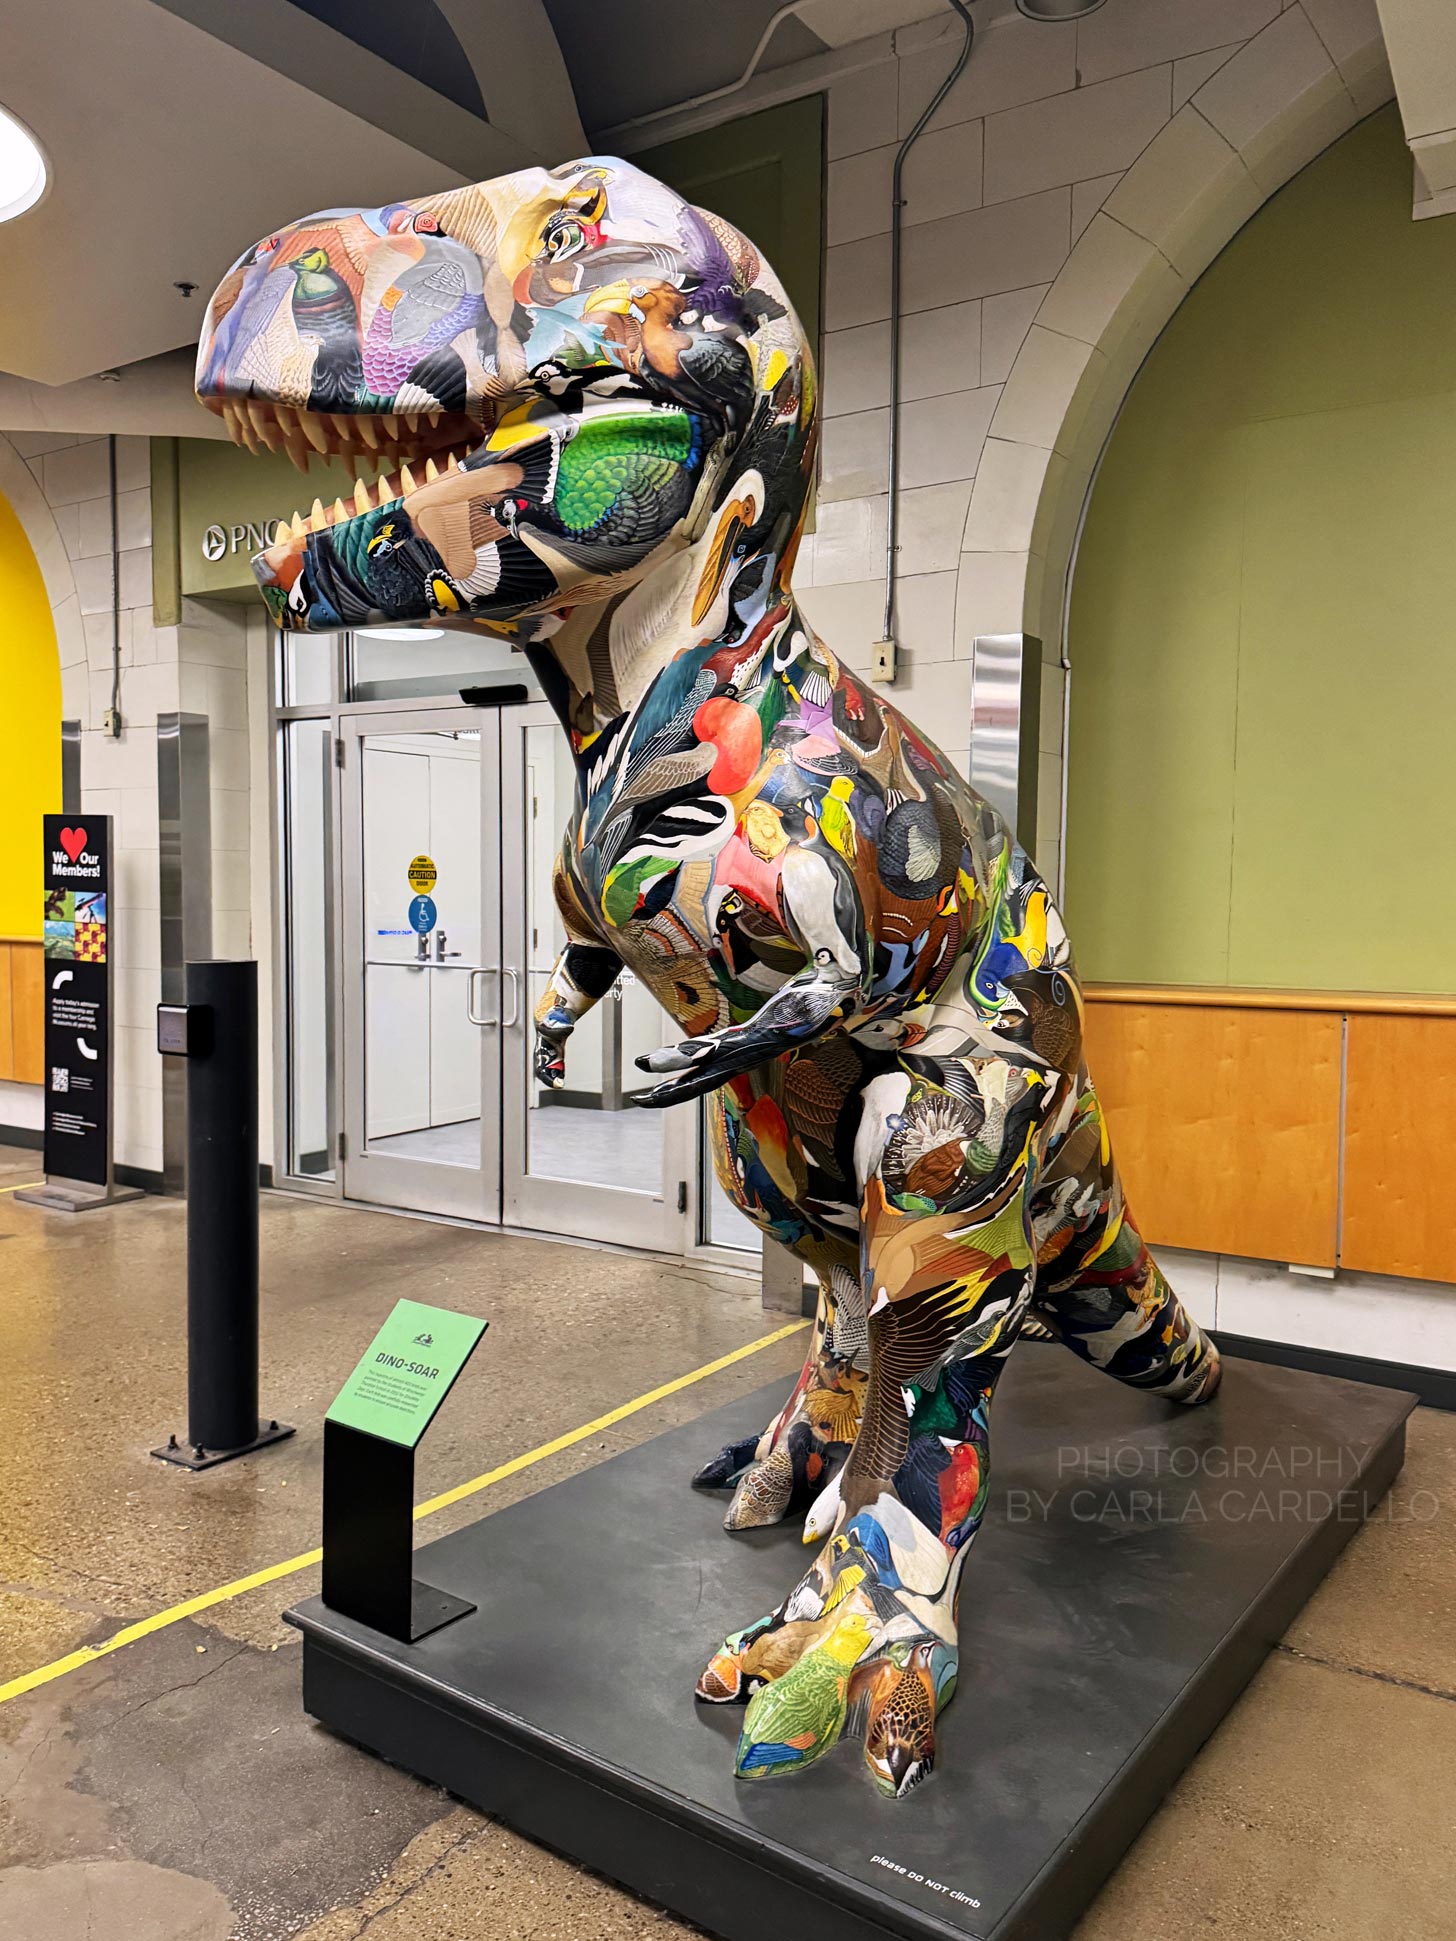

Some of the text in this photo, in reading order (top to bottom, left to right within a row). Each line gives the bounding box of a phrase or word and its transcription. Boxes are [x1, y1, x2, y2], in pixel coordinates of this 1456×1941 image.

[52, 851, 99, 865] We Our
[52, 864, 100, 878] Members!
[410, 871, 436, 879] CAUTION
[375, 1352, 440, 1380] DINO-SOAR
[869, 1854, 981, 1909] please DO NOT climb
